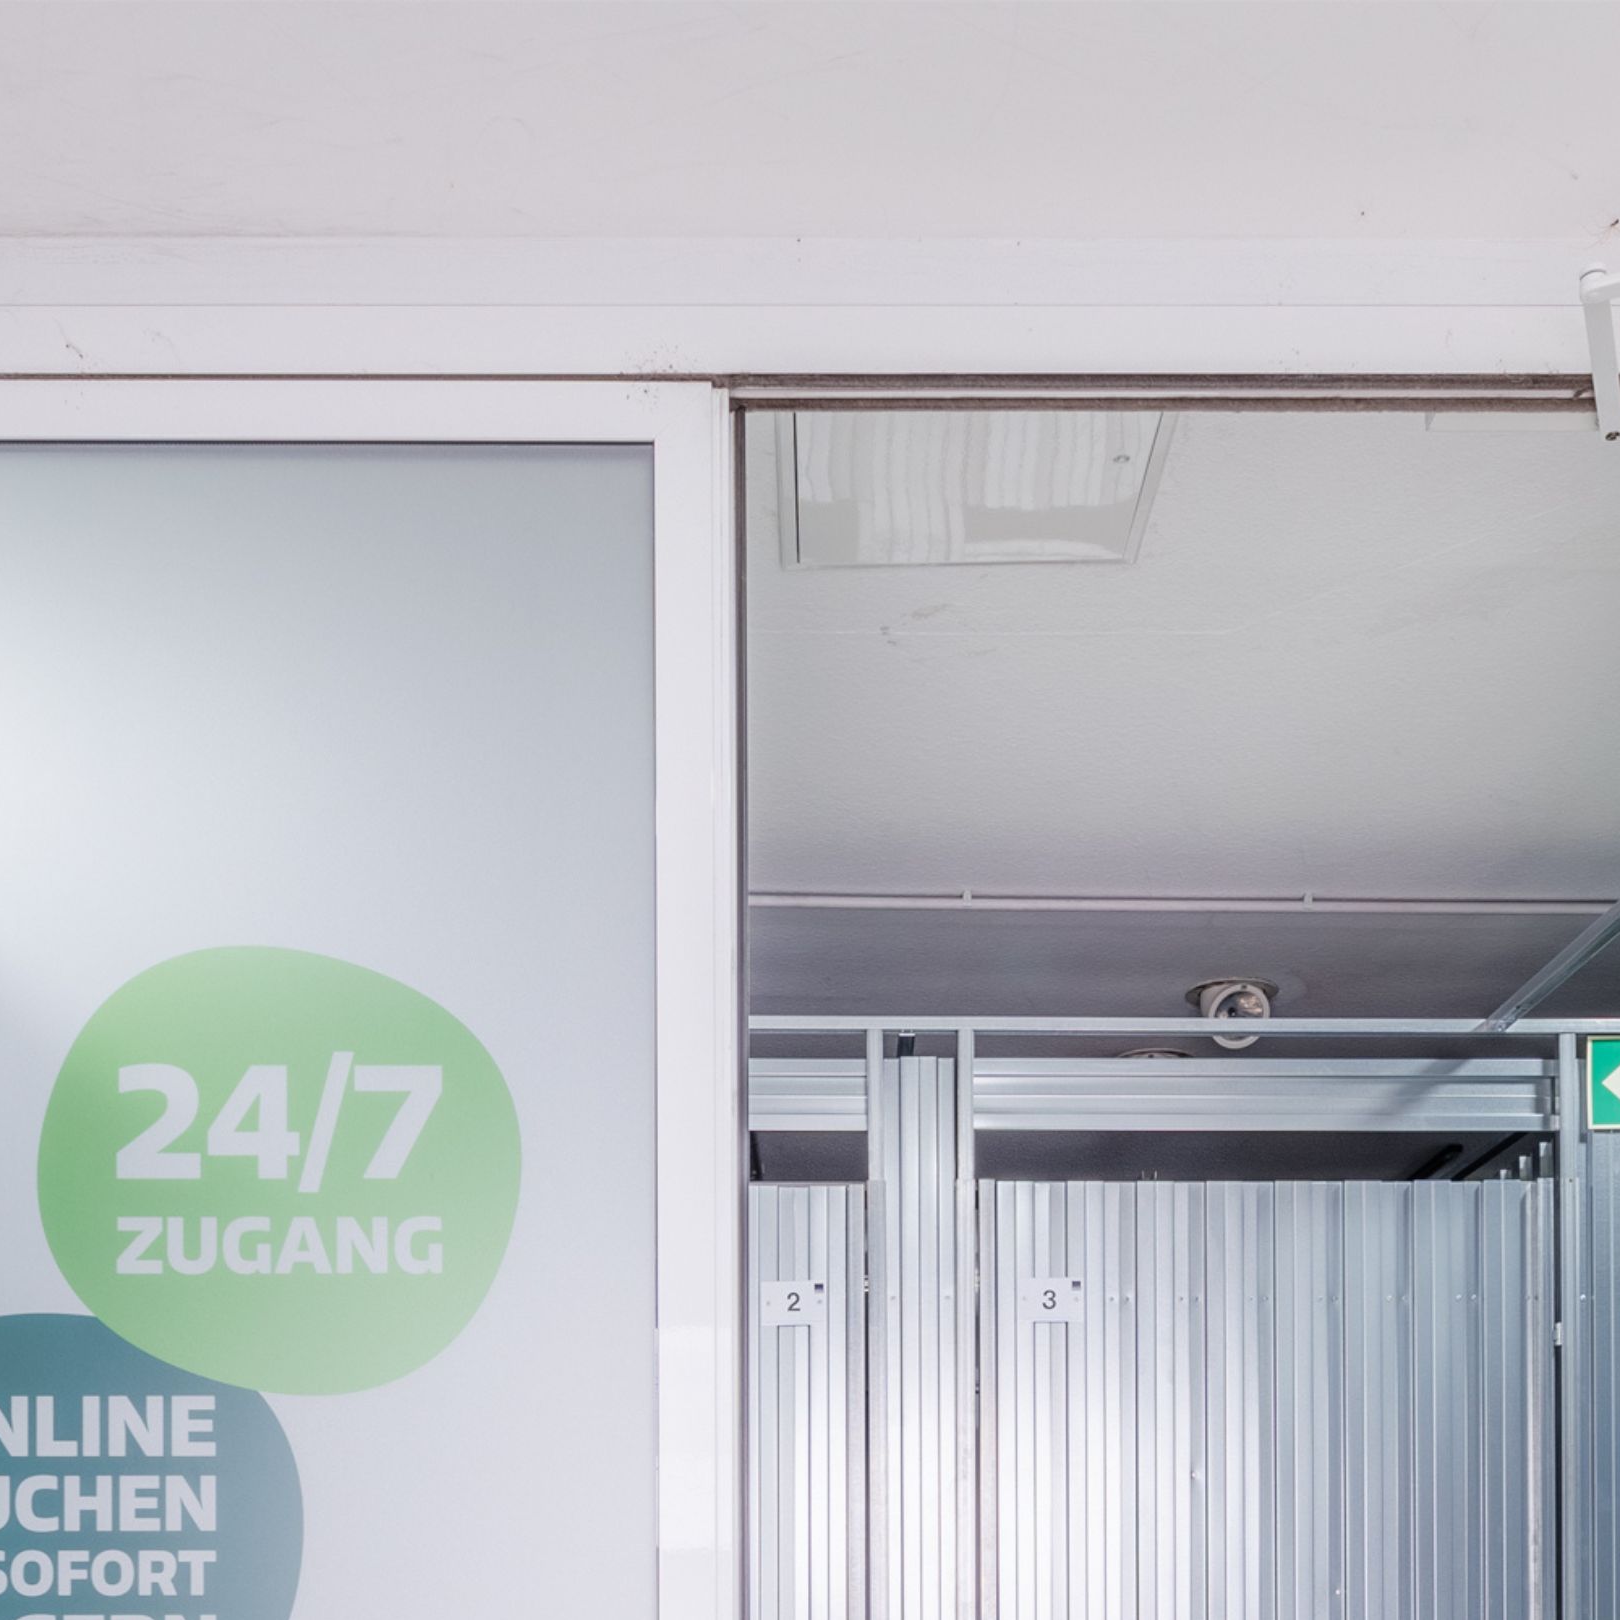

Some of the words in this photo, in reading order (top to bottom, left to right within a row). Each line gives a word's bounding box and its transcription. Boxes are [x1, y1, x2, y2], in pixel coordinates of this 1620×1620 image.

[116, 1050, 444, 1194] 24/7
[116, 1215, 444, 1275] ZUGANG
[786, 1292, 801, 1312] 2
[1042, 1289, 1057, 1310] 3
